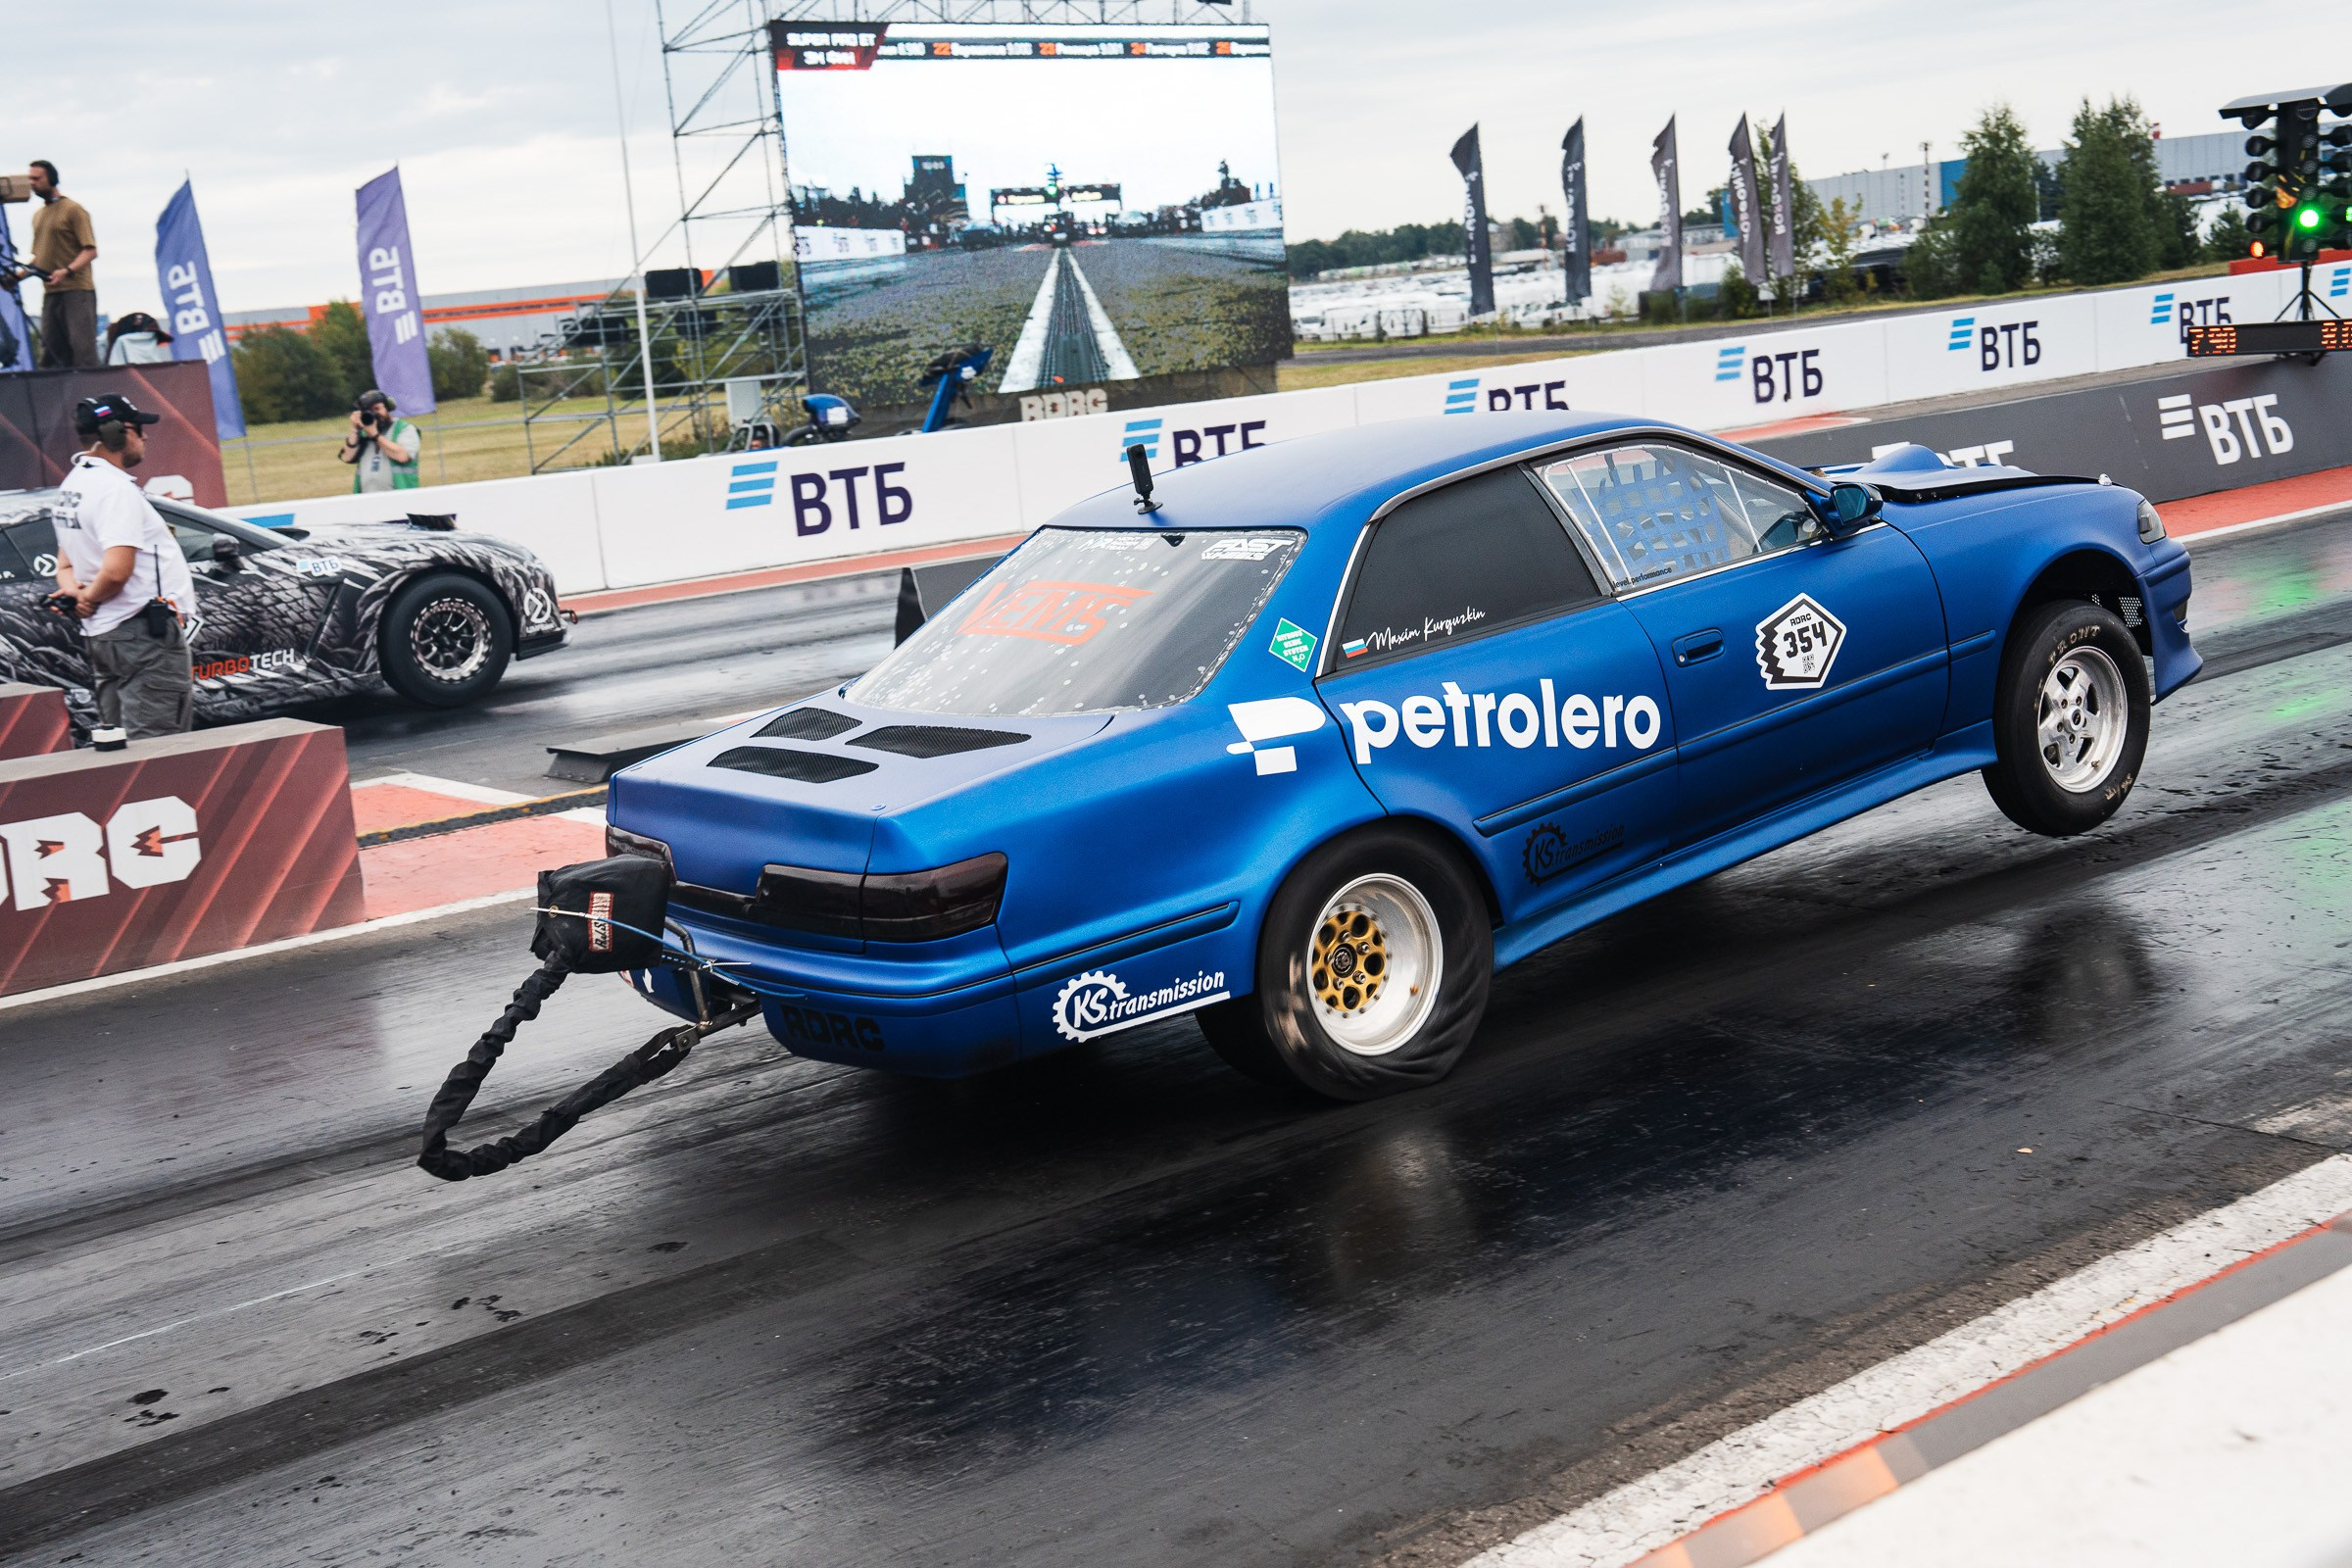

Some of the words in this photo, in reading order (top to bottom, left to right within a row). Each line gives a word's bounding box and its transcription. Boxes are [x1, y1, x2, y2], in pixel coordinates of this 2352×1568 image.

[168, 261, 211, 335] ВТБ
[368, 246, 408, 315] ВТБ
[1981, 320, 2041, 371] ВТБ
[1752, 349, 1824, 404] ВТБ
[2198, 394, 2294, 466] ВТБ
[790, 462, 913, 537] ВТБ
[312, 559, 339, 573] ВТБ
[1203, 538, 1296, 554] FAST
[956, 581, 1156, 646] VEMS
[1365, 626, 1421, 651] Maxim
[1423, 606, 1486, 642] Kurguzkin
[1784, 620, 1828, 659] 354
[1789, 612, 1812, 627] RDRC
[191, 648, 295, 681] TURBOTECH
[1339, 678, 1661, 764] petrolero
[0, 796, 202, 911] RC
[780, 1003, 885, 1052] RDRC
